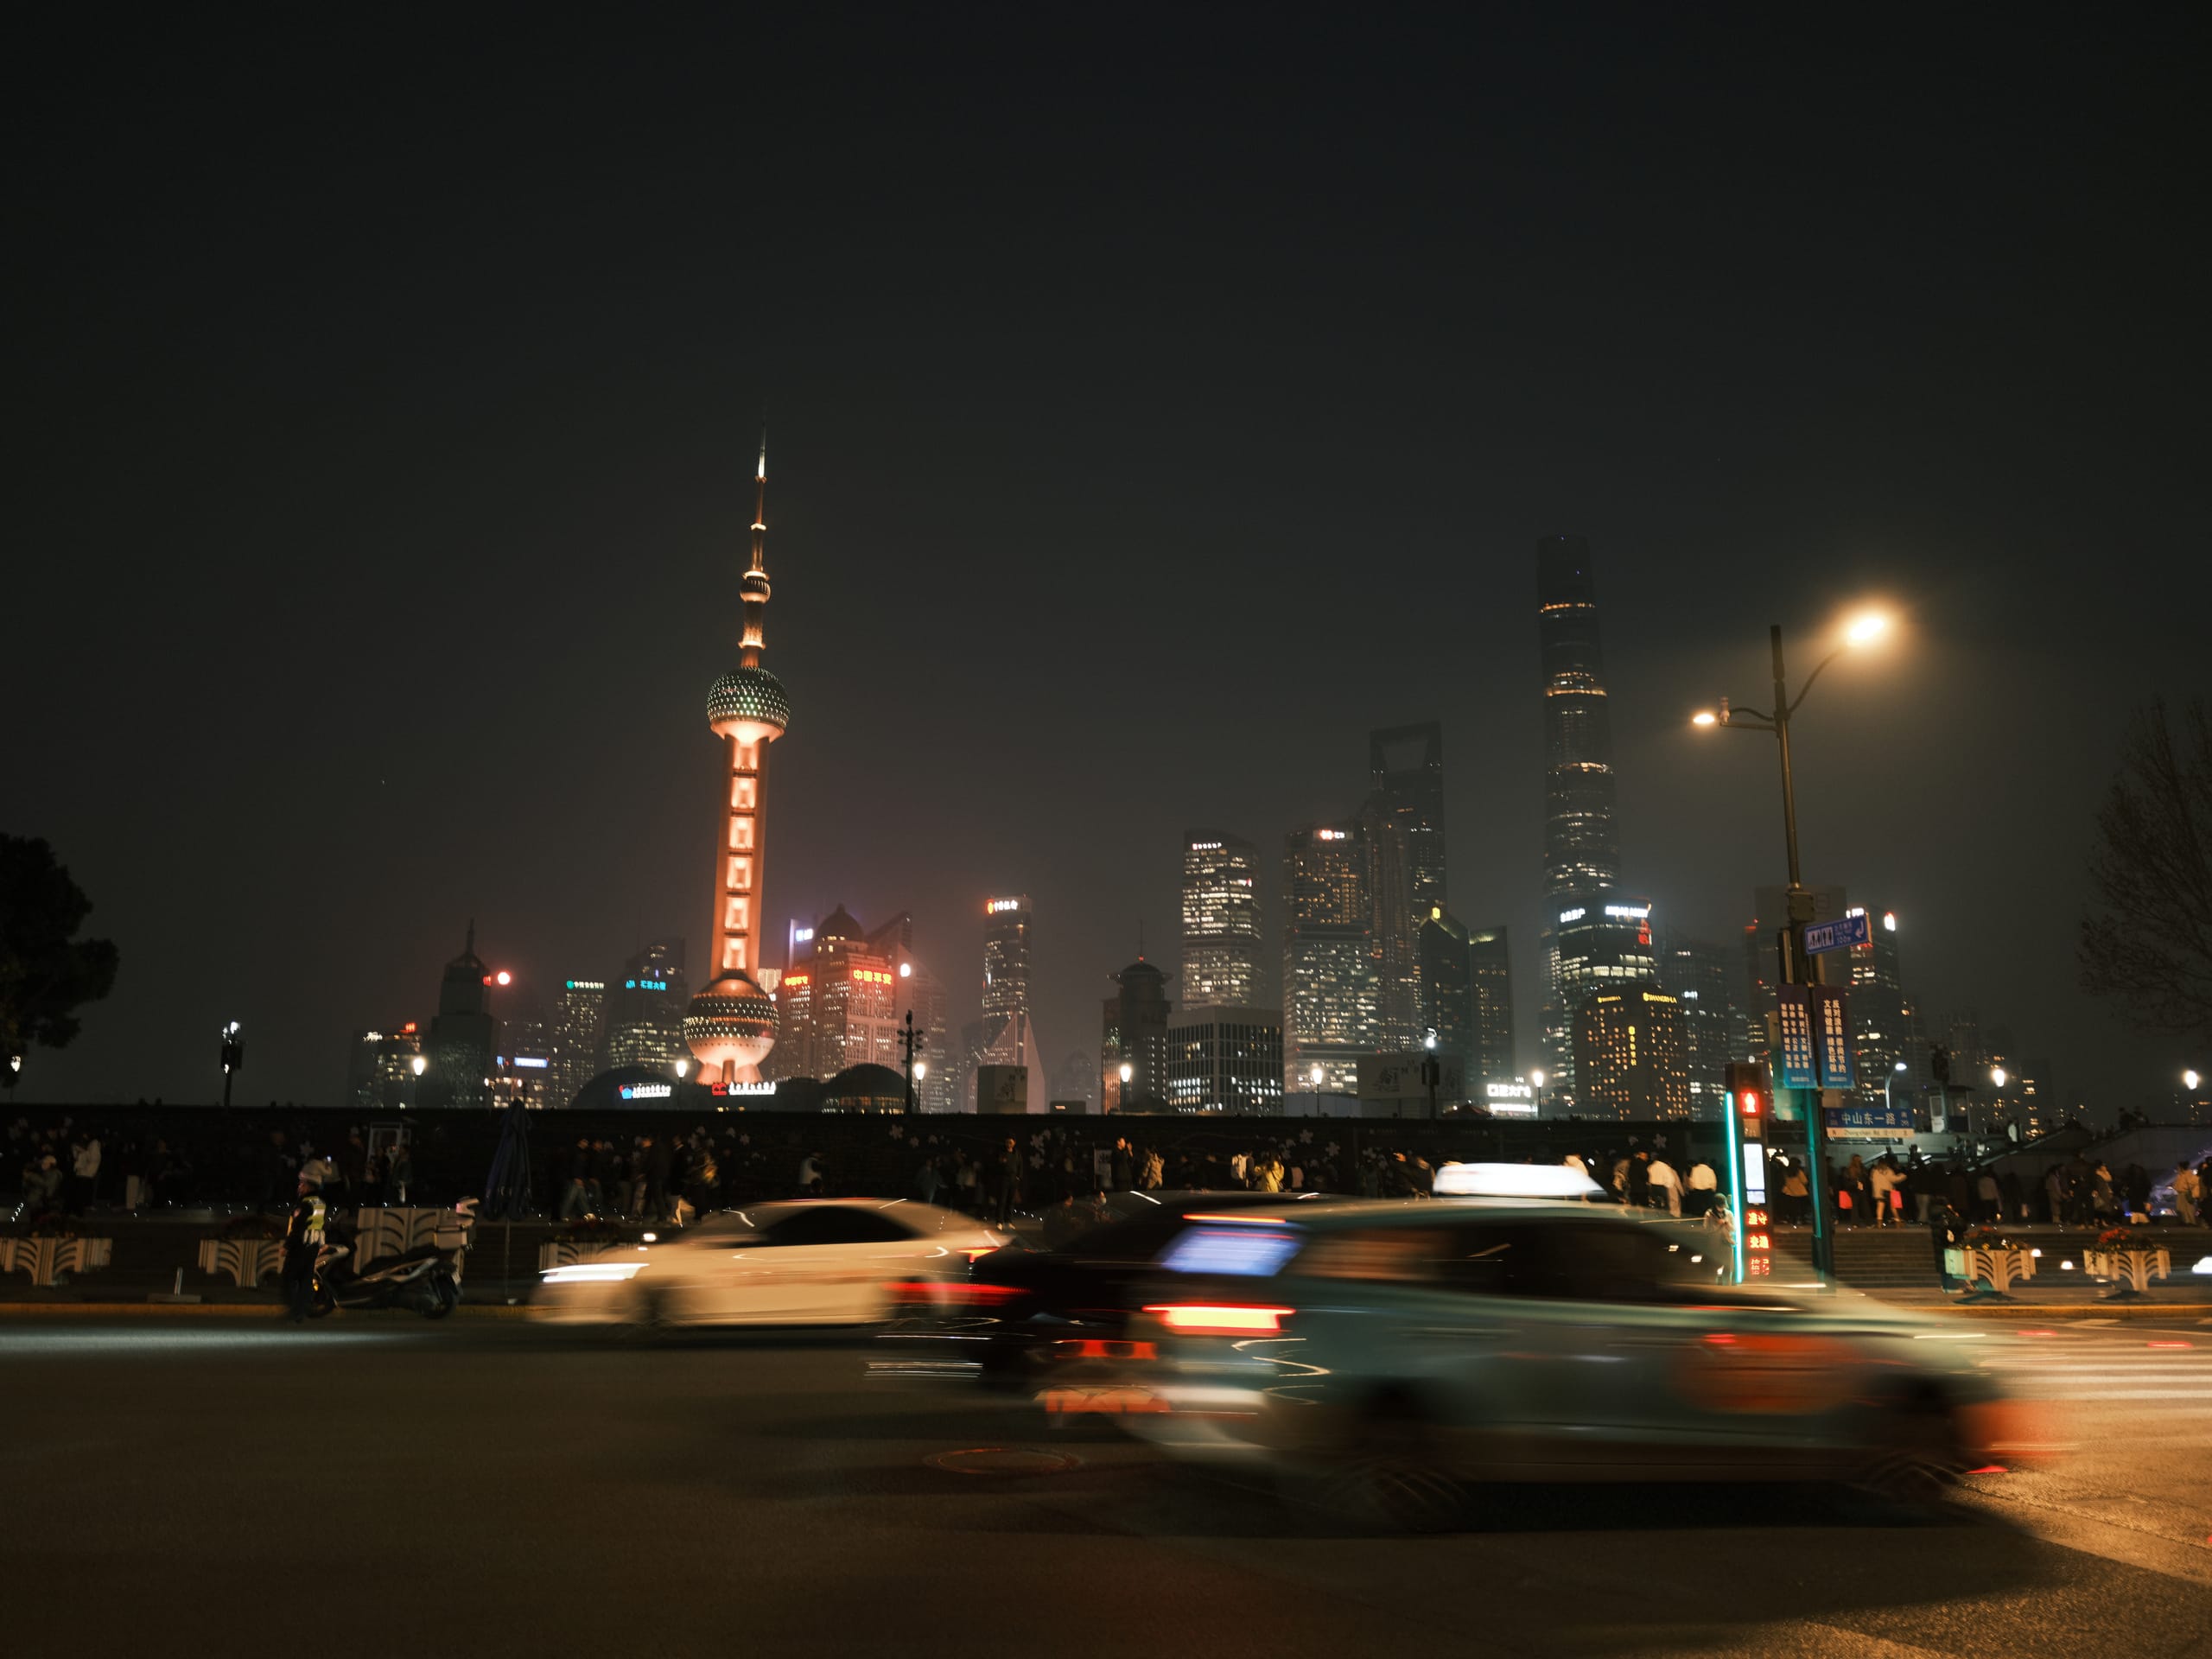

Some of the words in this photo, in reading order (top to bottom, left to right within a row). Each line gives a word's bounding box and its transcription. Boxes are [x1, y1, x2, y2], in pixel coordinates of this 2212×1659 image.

[854, 969, 892, 985] 中国平安
[1841, 1111, 1896, 1125] 中山东一路
